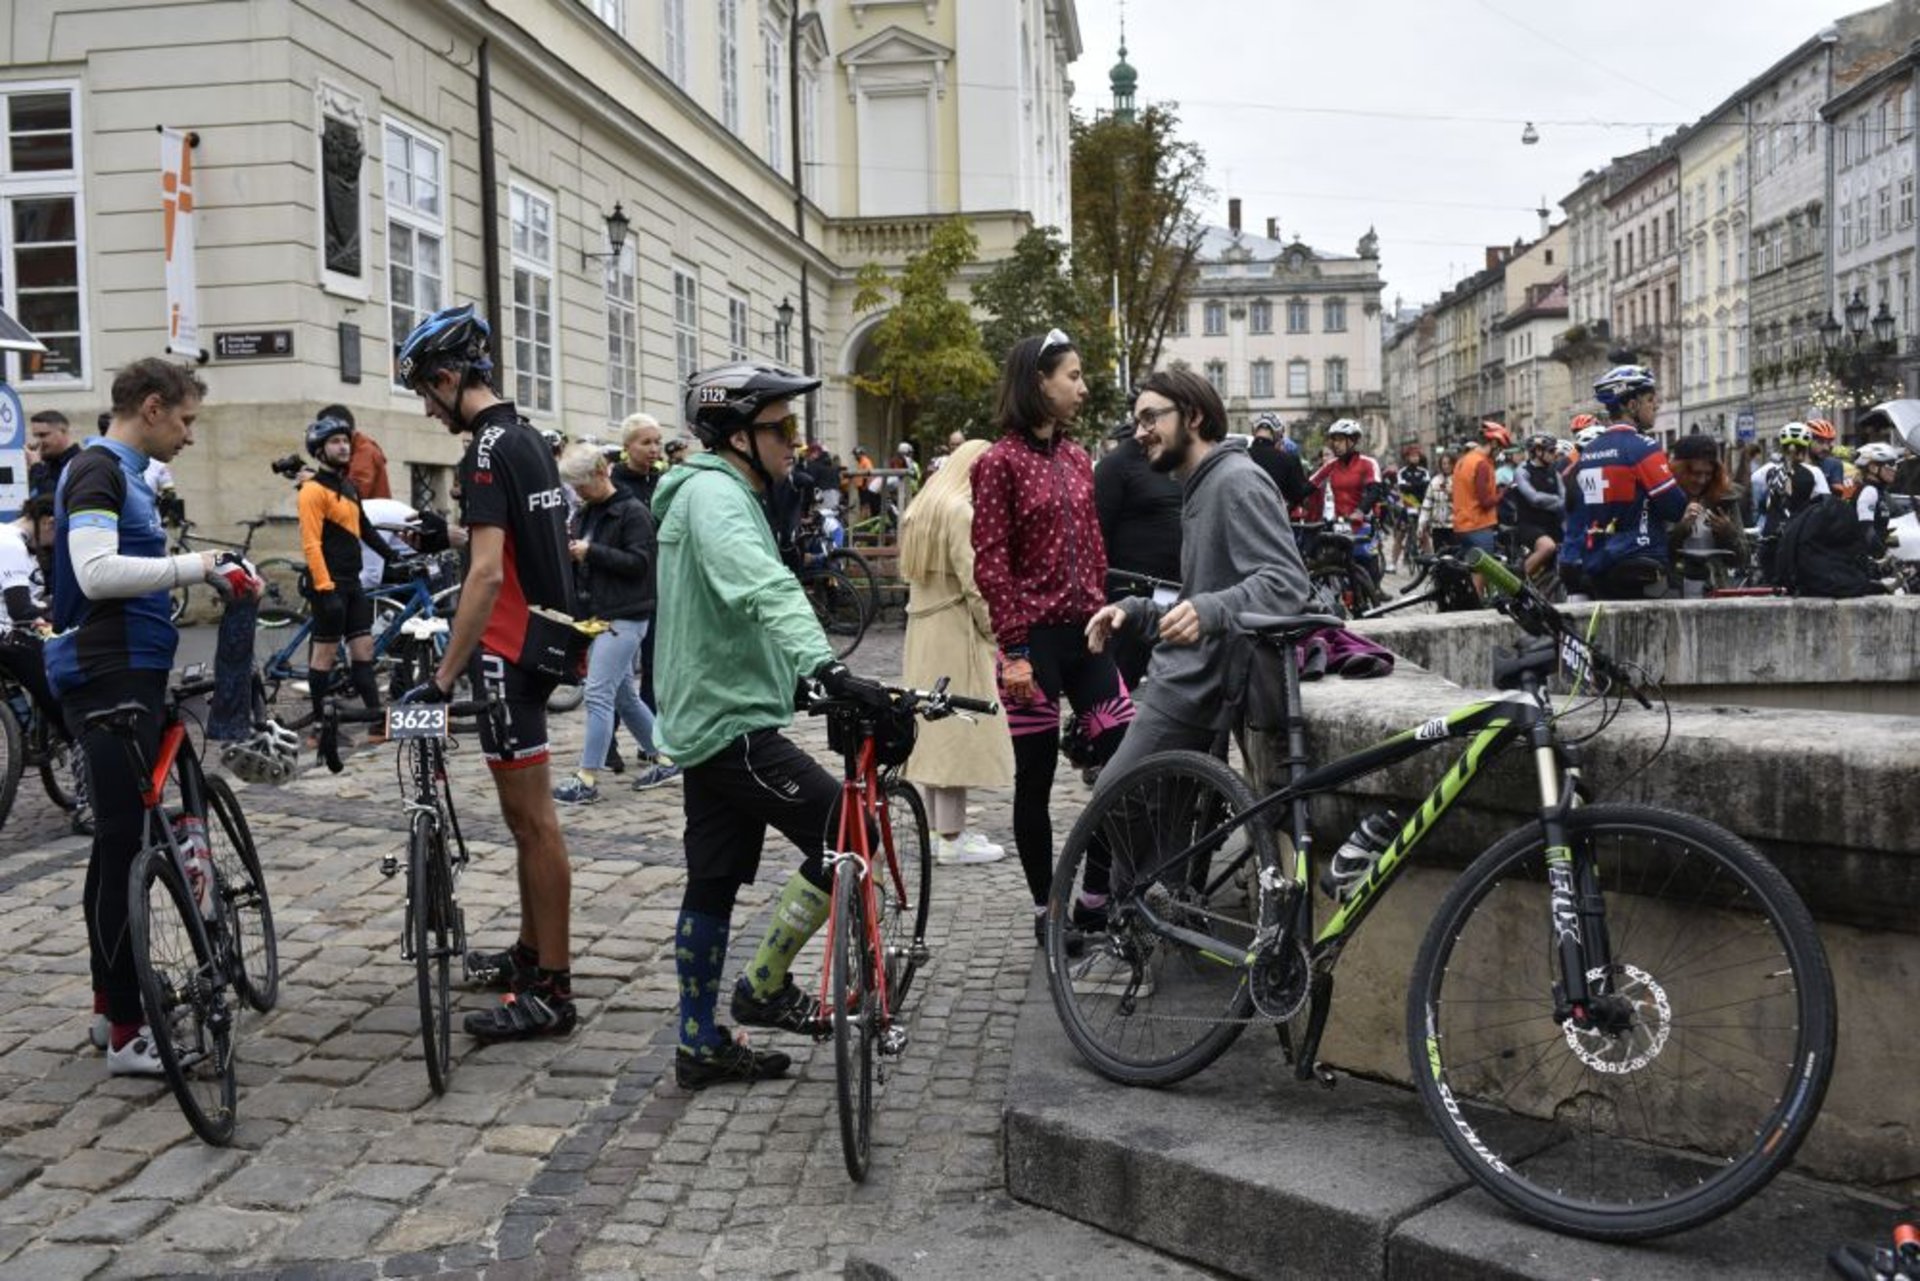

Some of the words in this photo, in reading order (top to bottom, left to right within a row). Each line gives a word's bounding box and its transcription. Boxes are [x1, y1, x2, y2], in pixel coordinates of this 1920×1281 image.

[477, 425, 506, 469] FOCUS
[391, 709, 444, 729] 3623
[1342, 748, 1470, 925] SCOTT
